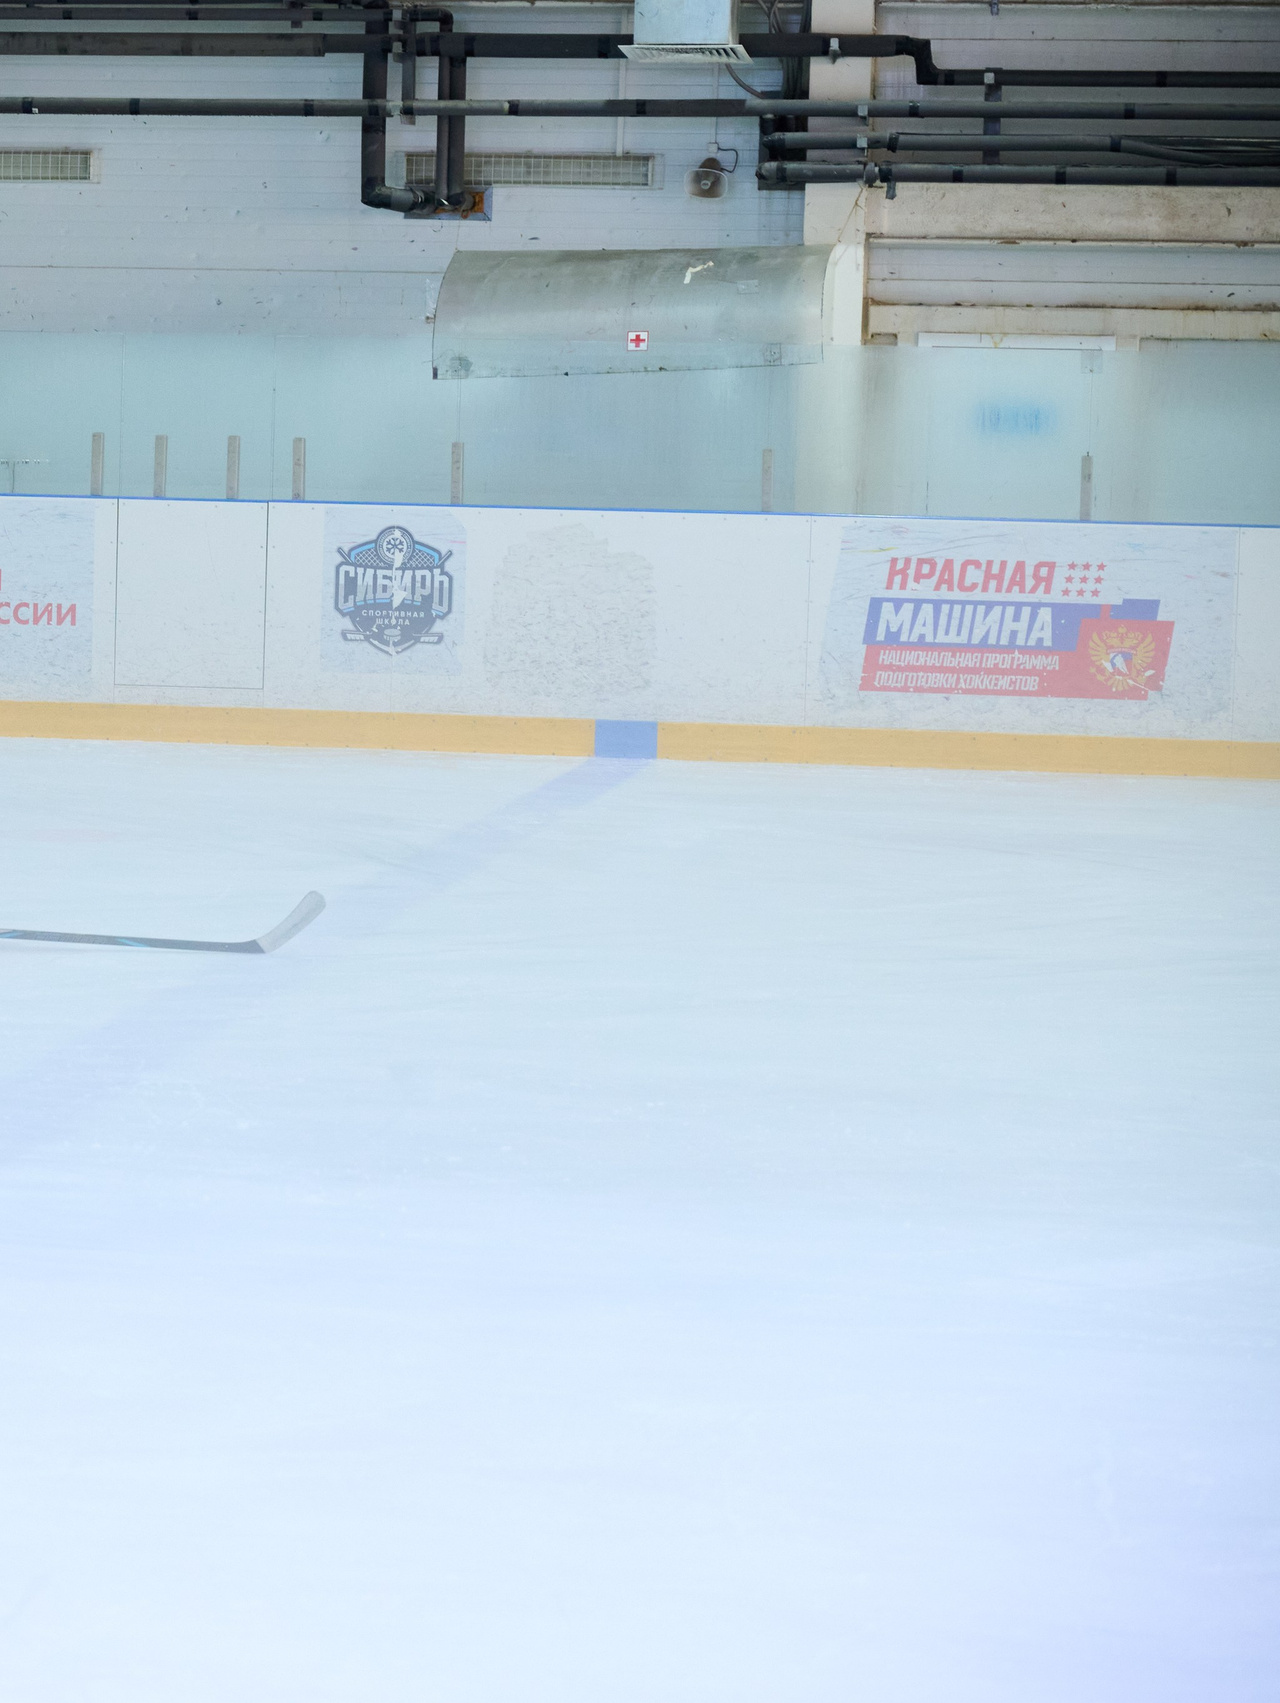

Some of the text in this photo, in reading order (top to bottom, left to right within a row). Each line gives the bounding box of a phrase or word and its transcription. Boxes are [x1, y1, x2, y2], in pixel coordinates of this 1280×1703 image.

[338, 564, 449, 613] СИБИРЬ
[885, 557, 1056, 594] КРАСНАЯ
[361, 609, 425, 618] СПОРТИВНАЯ
[876, 602, 1053, 647] МАШИНА
[878, 650, 1059, 670] НАЦИОНАЛЬНАЯ ПРОГРАММА
[875, 671, 1039, 691] ПОДГОТОВКИ ХОККЕИСТОВ
